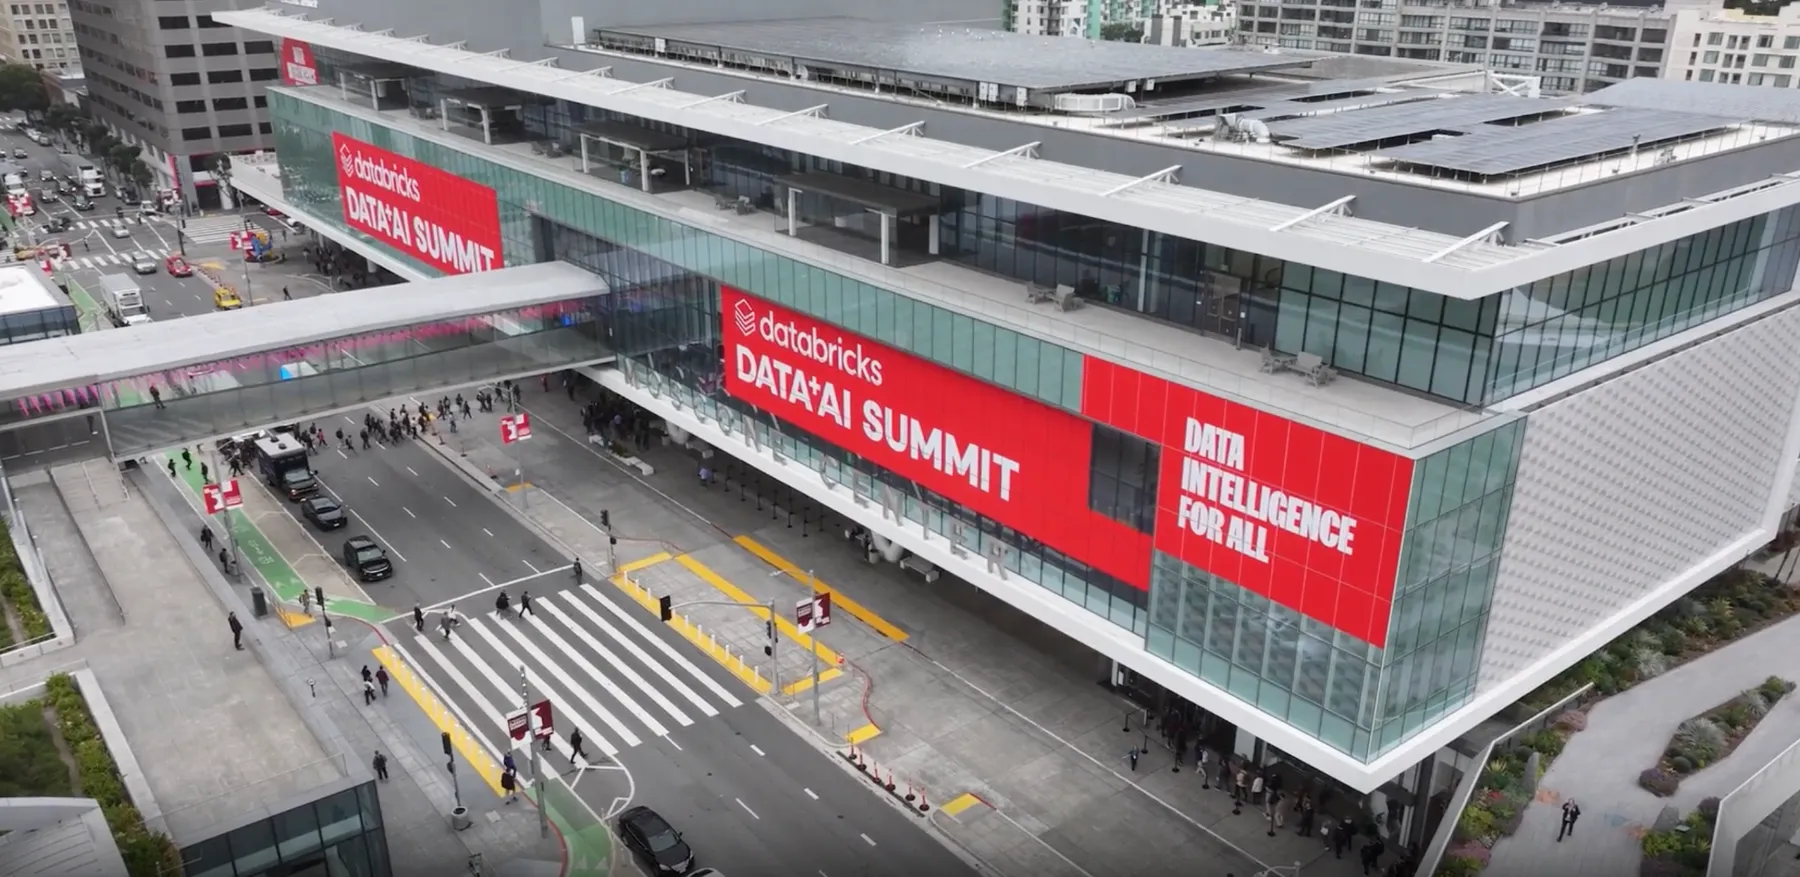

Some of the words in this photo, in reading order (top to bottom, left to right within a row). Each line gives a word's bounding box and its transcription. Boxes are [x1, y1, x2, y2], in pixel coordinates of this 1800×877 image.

[354, 150, 420, 202] databricks
[413, 216, 494, 273] SUMMIT
[760, 310, 883, 386] databricks
[623, 352, 788, 466] MOSCONE
[820, 454, 1009, 581] CENTER
[862, 400, 1020, 502] SUMMIT
[1184, 416, 1245, 472] DATA
[1178, 494, 1226, 545] FOR
[1226, 514, 1270, 564] ALL
[1181, 456, 1357, 556] INTELLIGENCE
